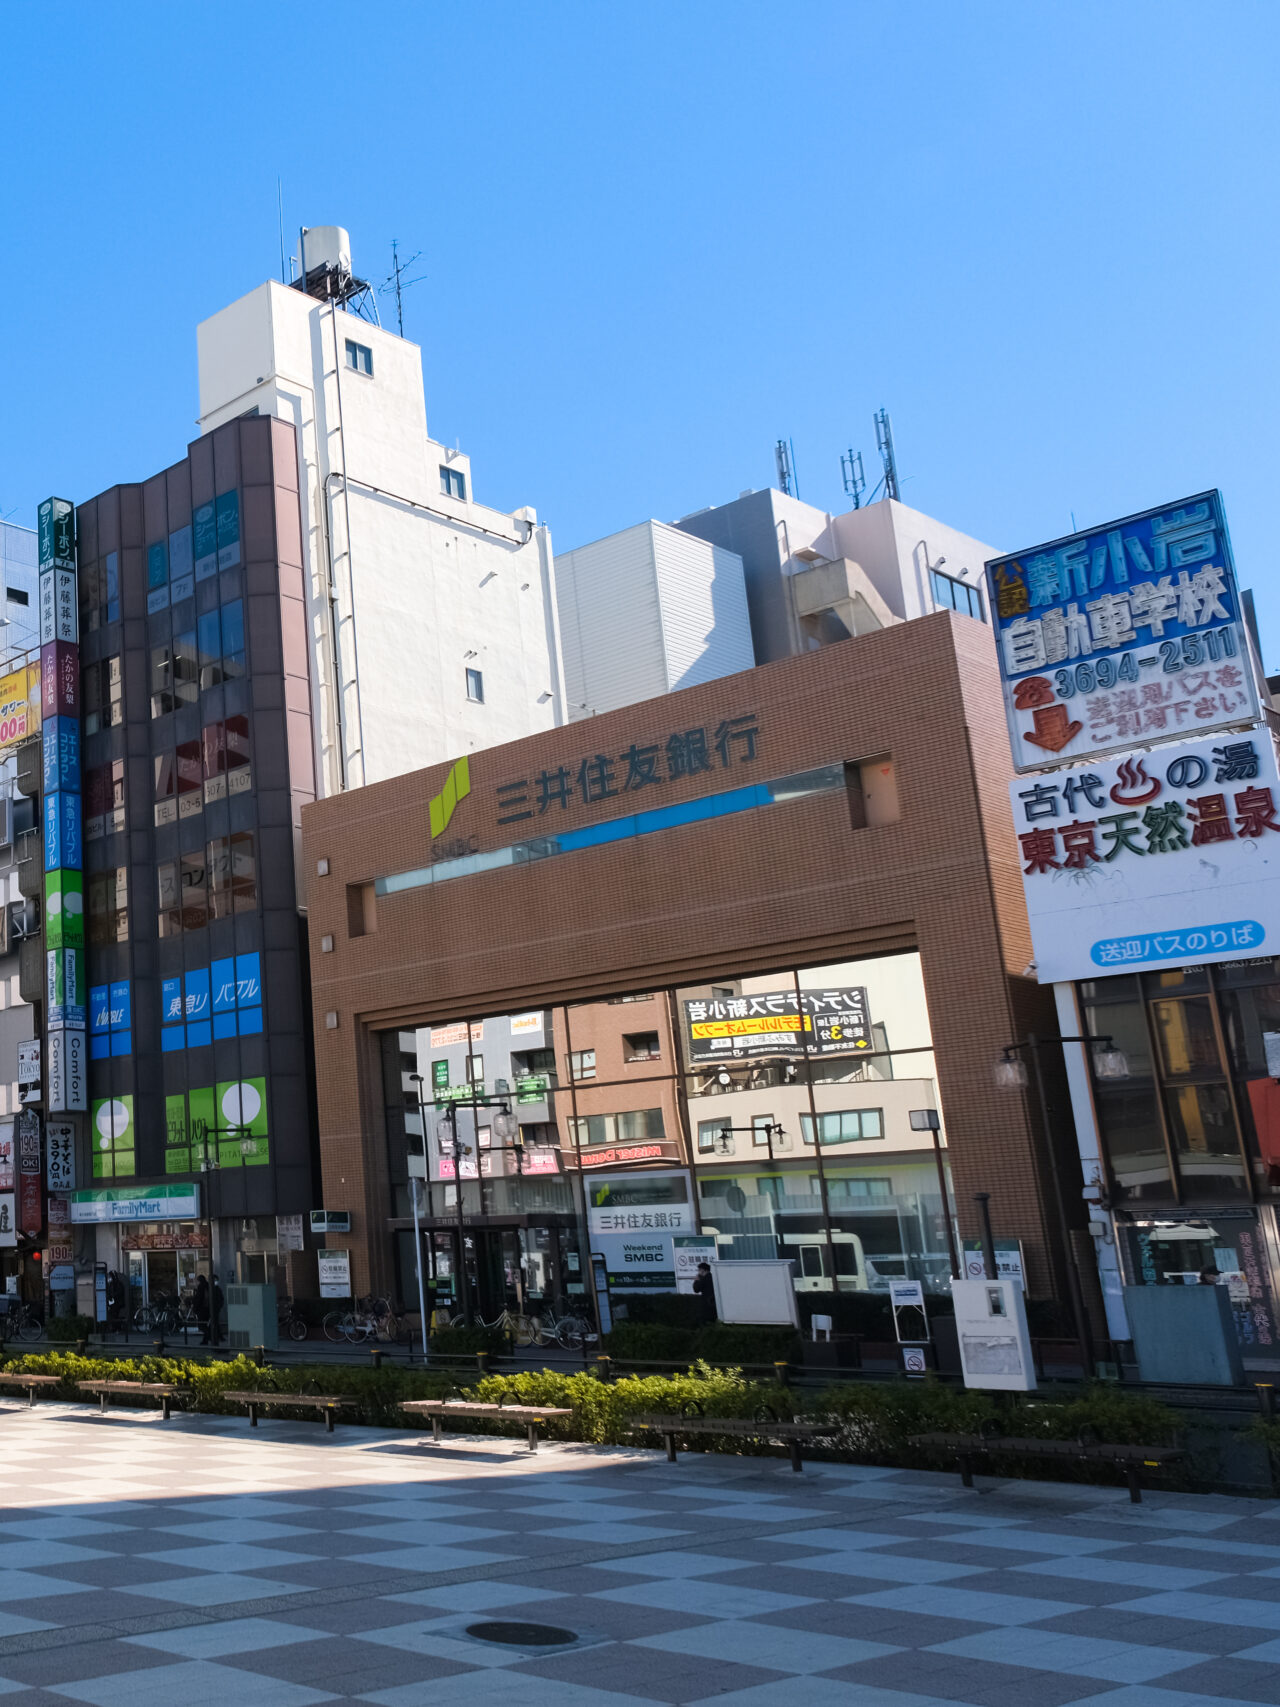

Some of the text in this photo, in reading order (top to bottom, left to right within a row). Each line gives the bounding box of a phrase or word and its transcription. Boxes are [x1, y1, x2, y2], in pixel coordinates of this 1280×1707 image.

[1026, 503, 1217, 607] 新小岩
[60, 575, 72, 637] 伊藤葬祭
[1003, 563, 1230, 675] 自動車学校
[65, 654, 74, 704] たかの友梨
[1055, 626, 1238, 698] 3694-2511
[496, 714, 759, 826] 三井住友銀行
[1019, 741, 1259, 822] 古代 の湯
[47, 797, 57, 867] 東急リバブル
[65, 796, 77, 864] 東急リバブル
[1019, 786, 1280, 875] 東京天然温泉
[1100, 924, 1255, 962] 送迎バスのりば
[167, 979, 259, 1018] 東急リバブル
[53, 1038, 61, 1103] Comfort
[71, 1038, 81, 1103] Comfort
[23, 1158, 37, 1168] OK!
[61, 1128, 71, 1176] 中華そば
[112, 1201, 160, 1218] FamilyMart
[600, 1212, 682, 1230] 三井住友銀行
[623, 1243, 663, 1252] Weekend
[624, 1253, 664, 1263] SMBC
